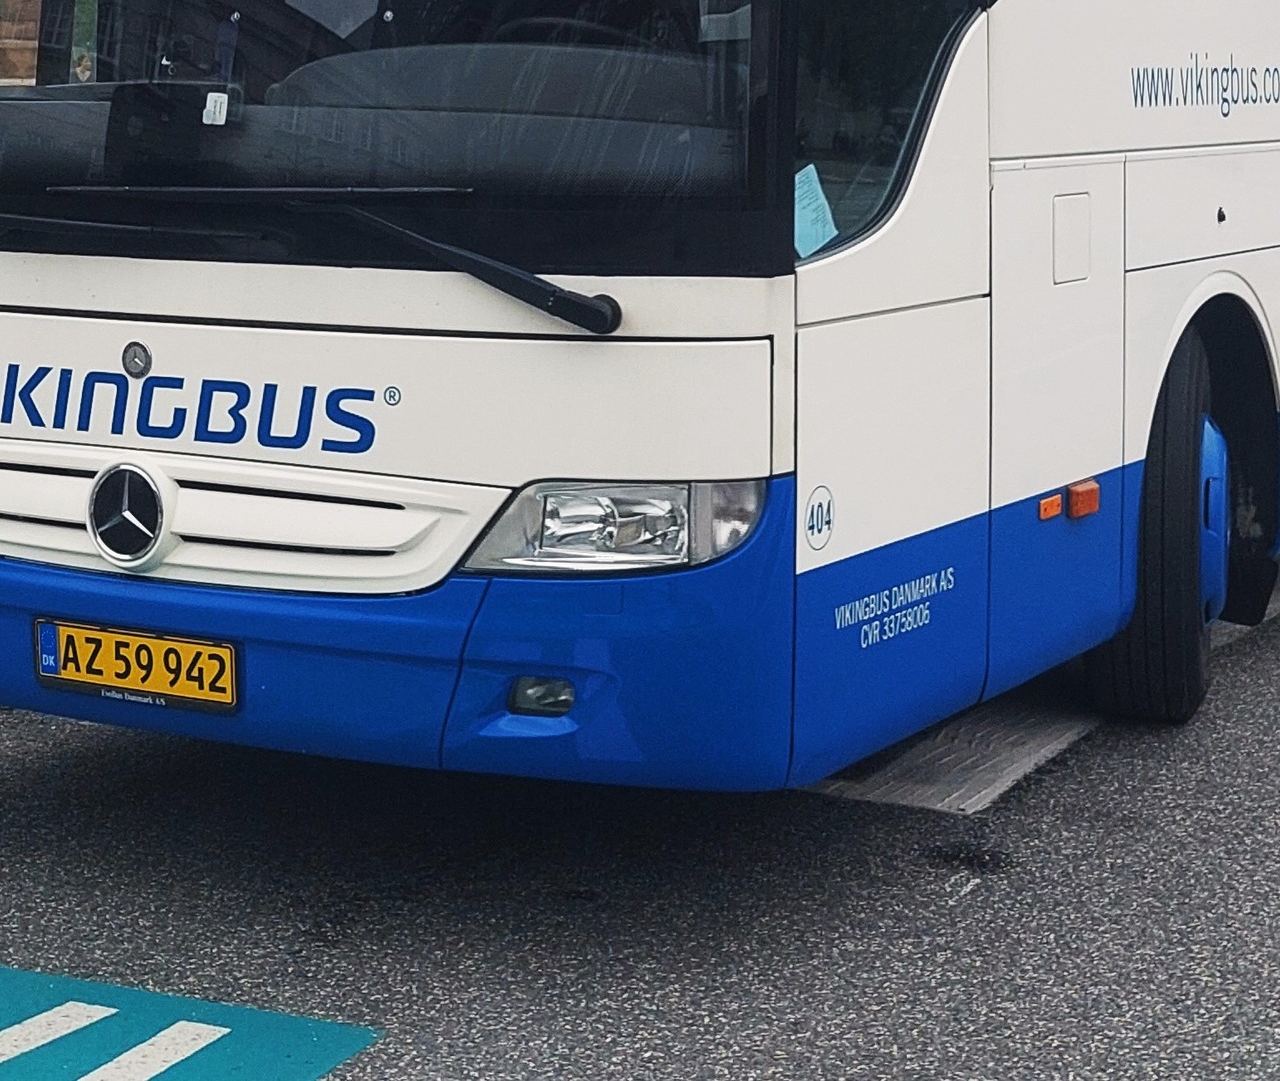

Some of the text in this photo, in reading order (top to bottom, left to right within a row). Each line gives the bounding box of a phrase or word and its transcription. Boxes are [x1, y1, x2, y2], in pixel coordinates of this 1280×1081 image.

[808, 499, 831, 536] 404
[834, 590, 890, 629] VIKINGBUS
[891, 573, 937, 609] DANMARK
[860, 621, 880, 648] CVR
[42, 633, 228, 694] DK AZ 59 942
